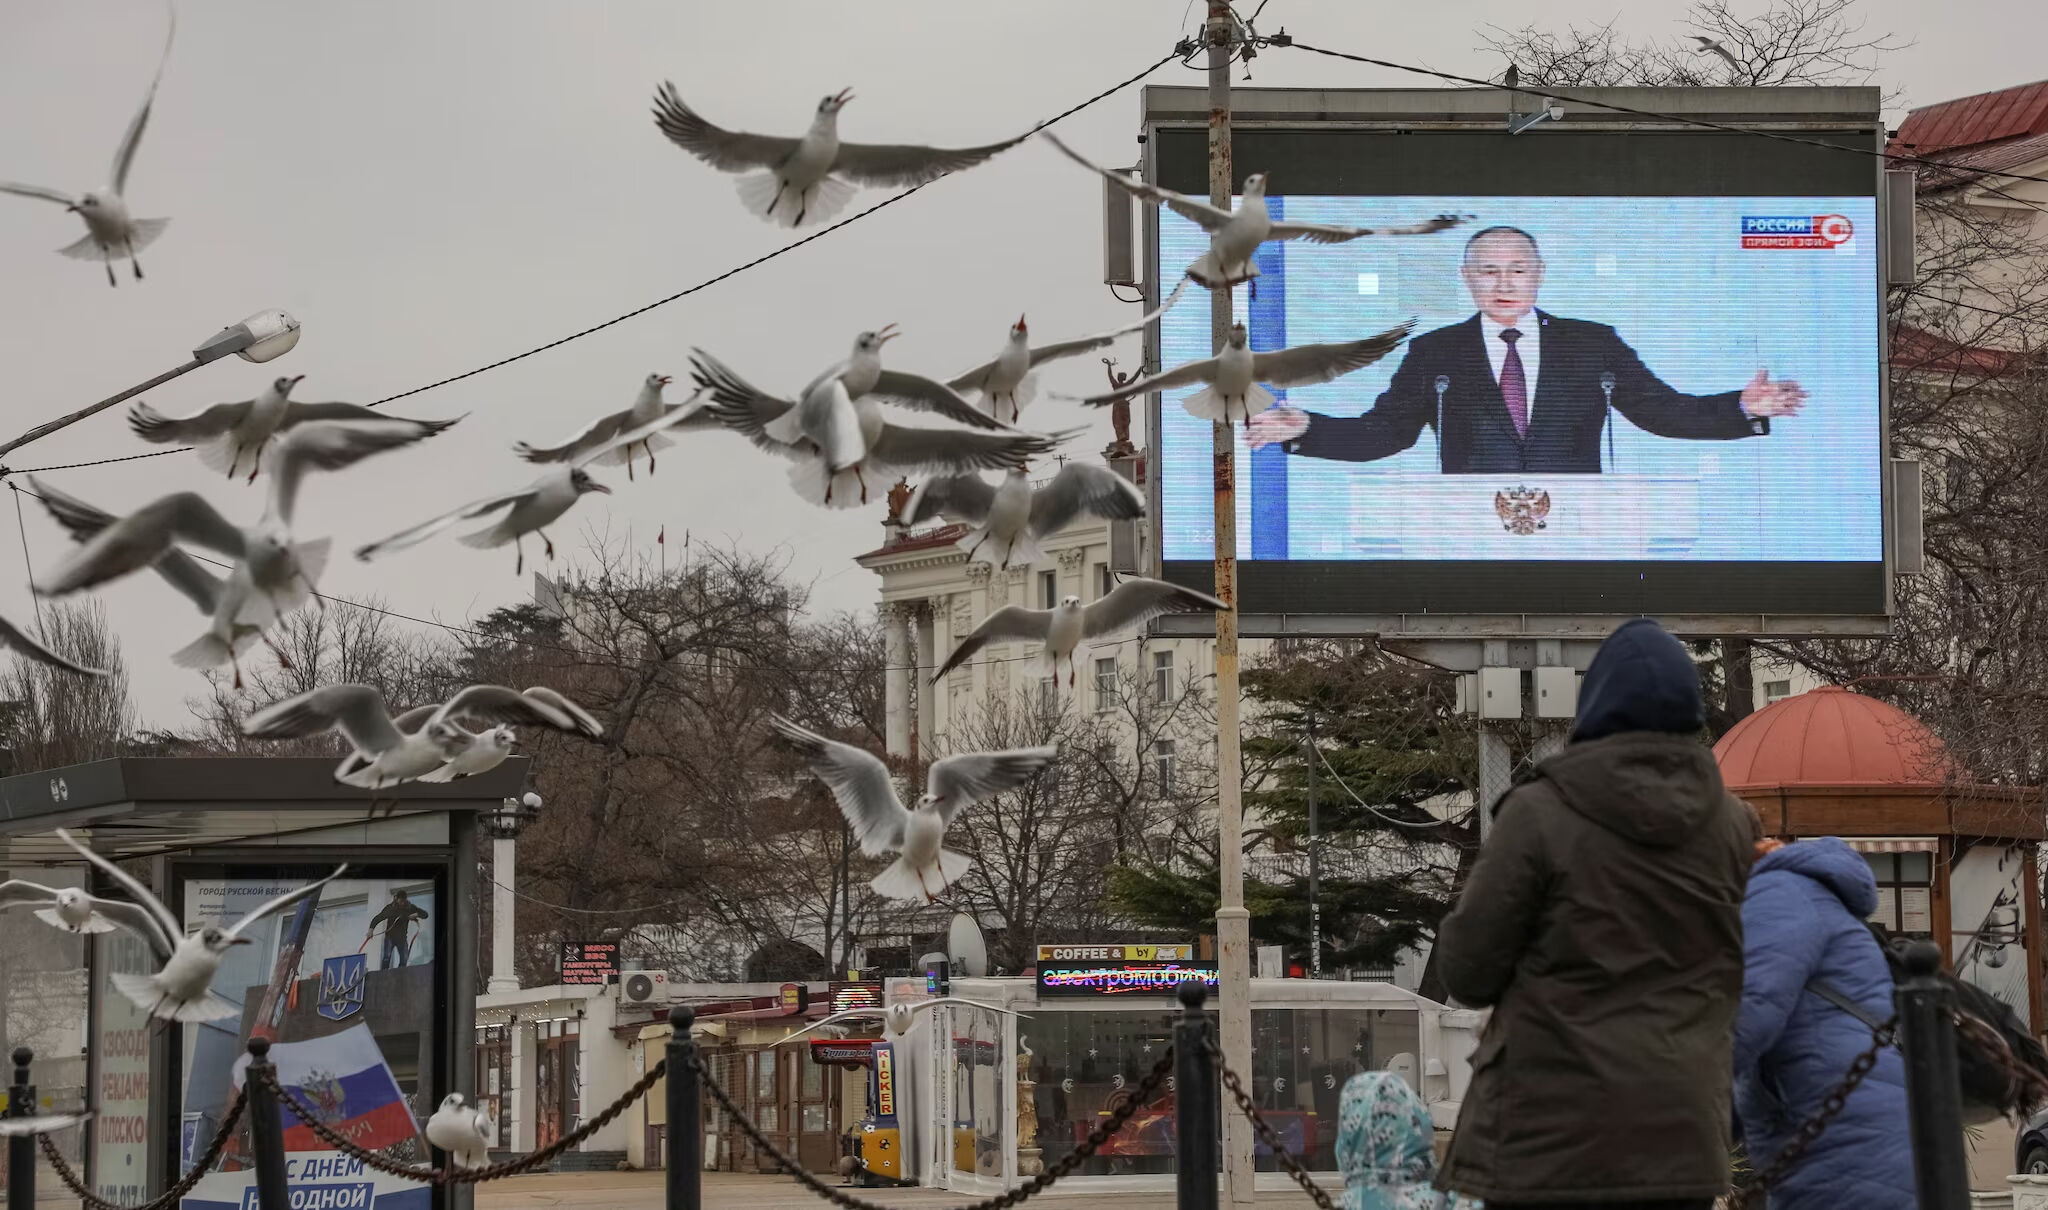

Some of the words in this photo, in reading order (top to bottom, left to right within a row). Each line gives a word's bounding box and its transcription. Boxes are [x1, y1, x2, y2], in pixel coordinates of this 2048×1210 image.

[1747, 219, 1806, 232] РОССИЯ
[1745, 236, 1795, 247] ПРЯМОЙ
[198, 887, 225, 896] ГОРОД
[227, 886, 264, 896] РУССКОЙ
[584, 944, 616, 952] МЯСО
[1052, 947, 1109, 960] COFFEE
[1111, 948, 1122, 958] &
[1136, 947, 1149, 958] by
[878, 1050, 892, 1113] KICKER
[100, 1116, 148, 1143] ПЛОСКО
[286, 1159, 298, 1179] С
[300, 1153, 365, 1181] ДНЁМ
[247, 1184, 368, 1210] НОДНОЙ
